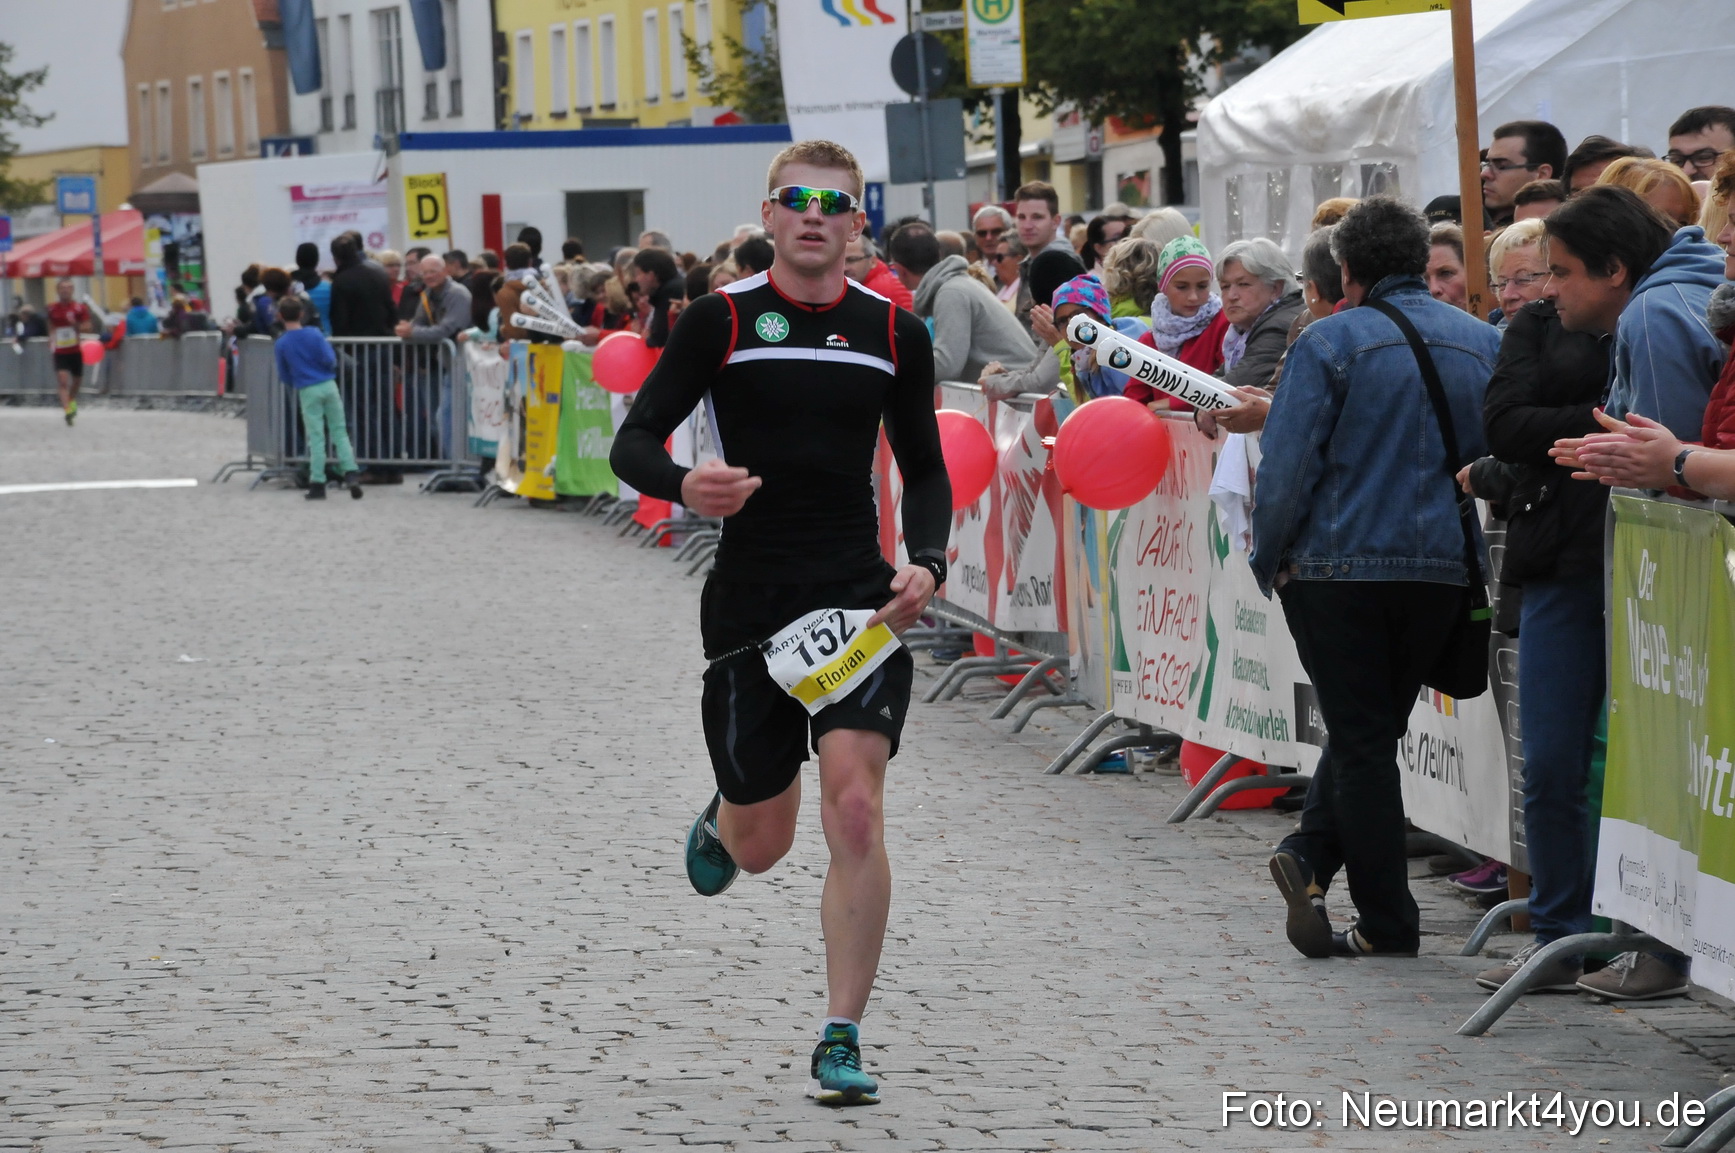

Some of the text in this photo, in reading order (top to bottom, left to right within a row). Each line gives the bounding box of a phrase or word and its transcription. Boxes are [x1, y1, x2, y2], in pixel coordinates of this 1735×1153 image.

[408, 177, 442, 189] Block
[417, 194, 439, 225] D
[1135, 360, 1183, 392] BMW
[1638, 549, 1657, 600] Der
[767, 634, 802, 659] PARTL
[792, 610, 857, 668] 152
[1627, 598, 1671, 694] Neue
[816, 647, 866, 690] Florian
